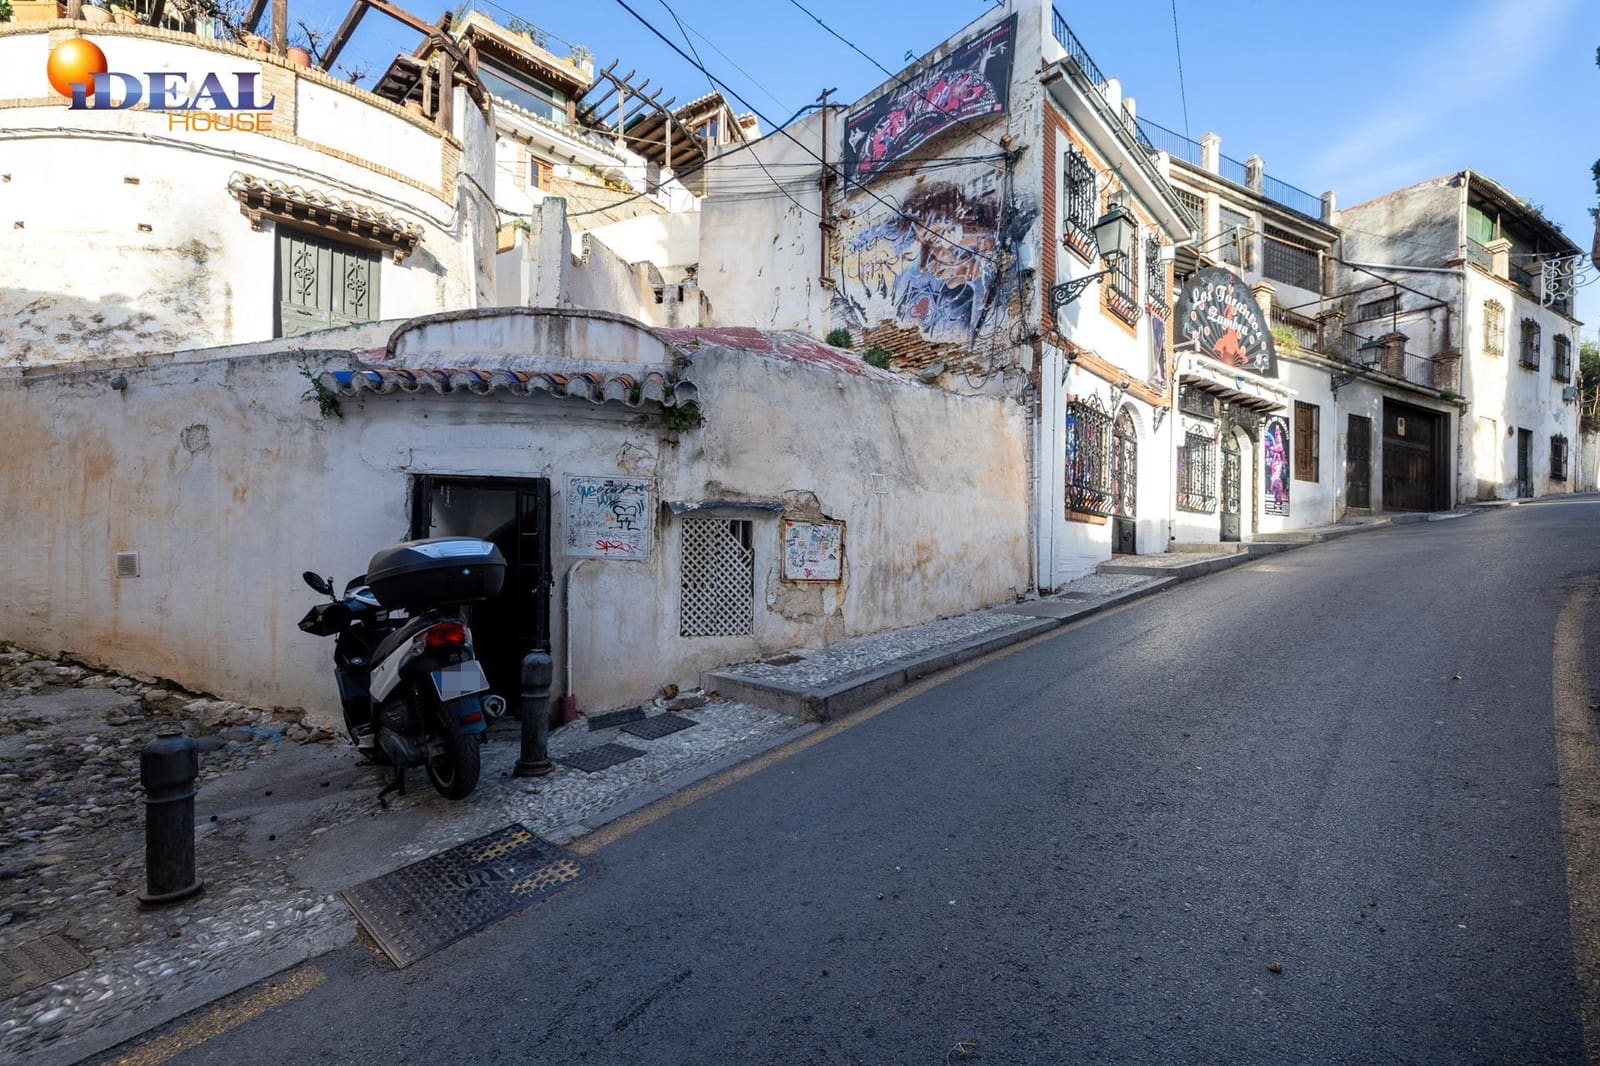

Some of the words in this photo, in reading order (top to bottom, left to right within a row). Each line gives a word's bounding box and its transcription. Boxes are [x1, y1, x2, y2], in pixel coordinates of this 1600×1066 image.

[1193, 288, 1213, 310] Los
[1216, 285, 1263, 339] Tarantos
[1207, 305, 1248, 335] Zambra
